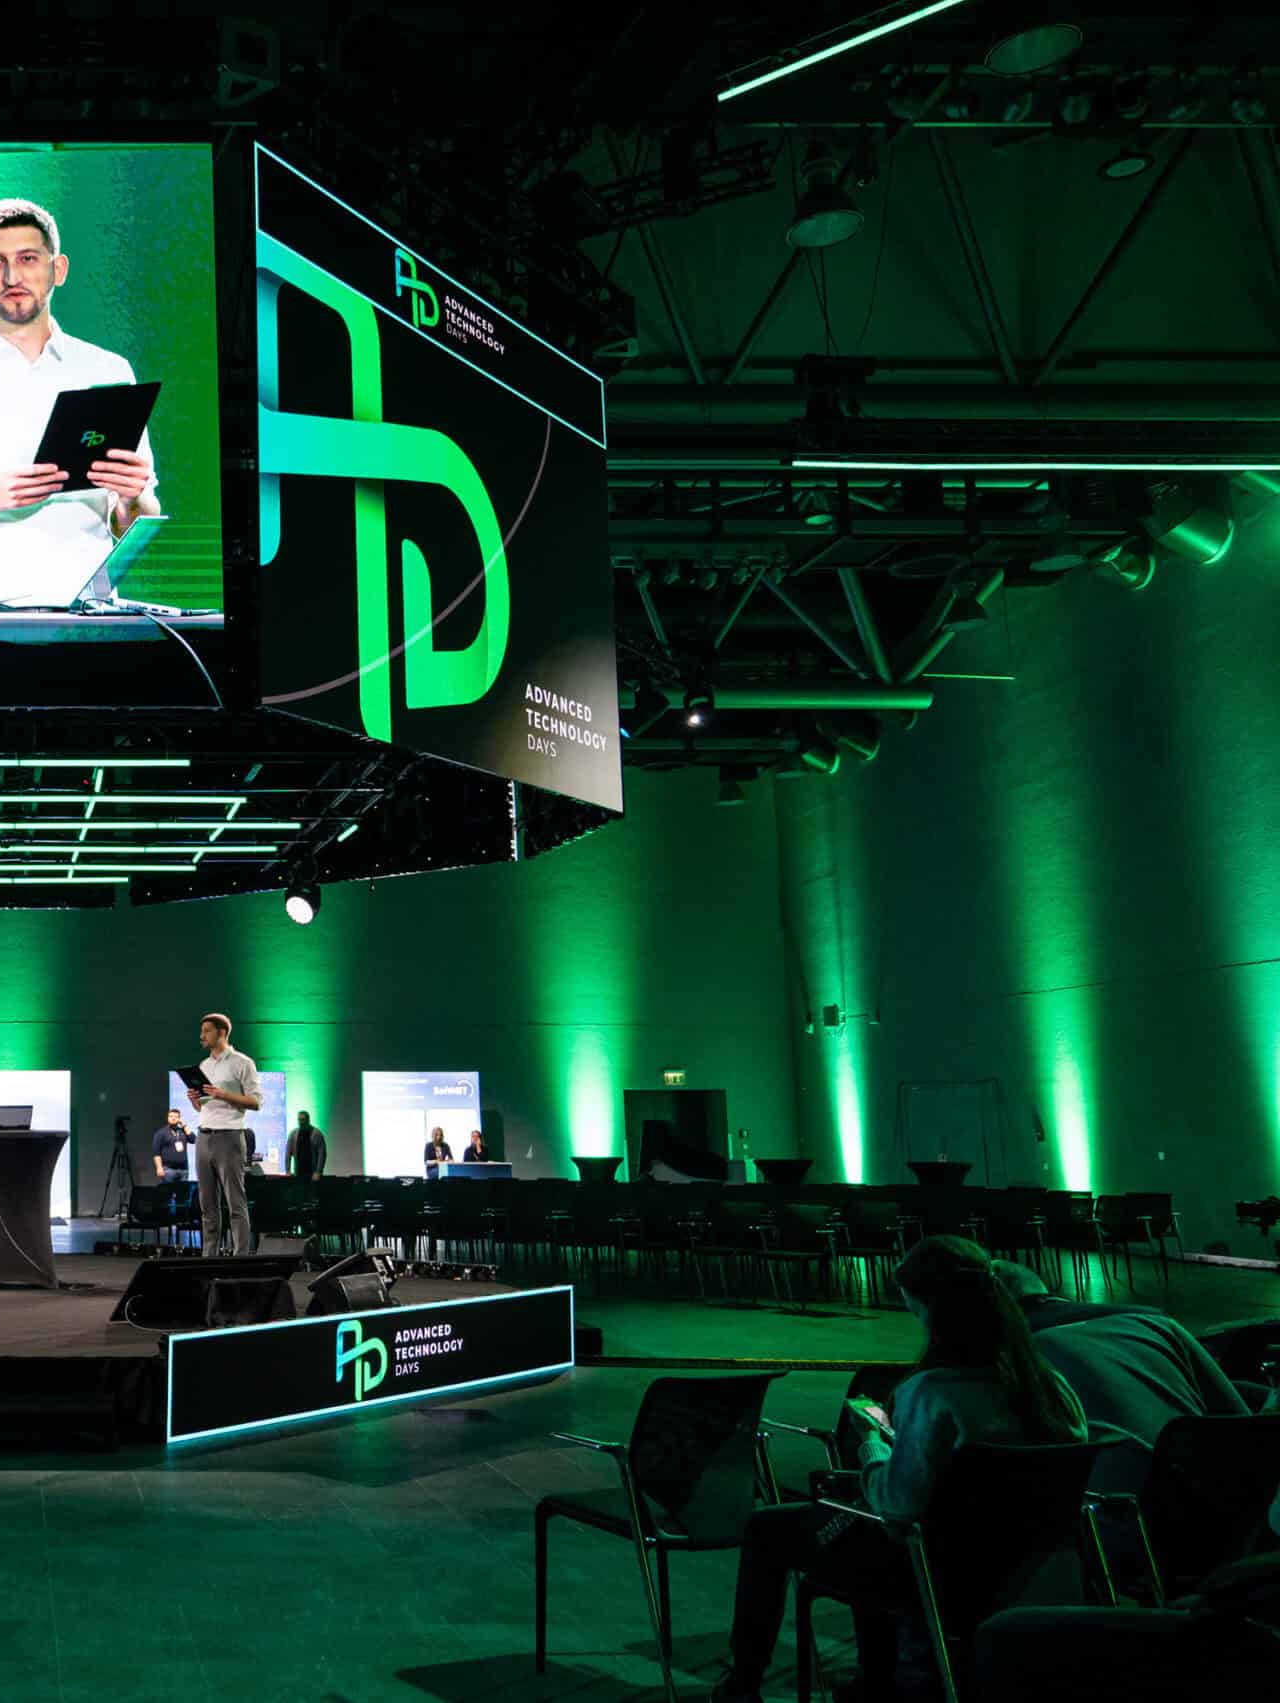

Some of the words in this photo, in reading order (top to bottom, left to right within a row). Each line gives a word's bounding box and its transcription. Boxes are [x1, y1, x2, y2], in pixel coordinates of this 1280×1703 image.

[445, 296, 494, 334] ADVANCED
[445, 309, 505, 355] TECHNOLOGY
[447, 323, 467, 343] DAYS
[525, 683, 592, 722] ADVANCED
[525, 708, 607, 752] TECHNOLOGY
[527, 734, 557, 757] DAYS
[395, 1324, 452, 1343] ADVANCED
[395, 1338, 464, 1360] TECHNOLOGY
[395, 1362, 420, 1377] DAYS
